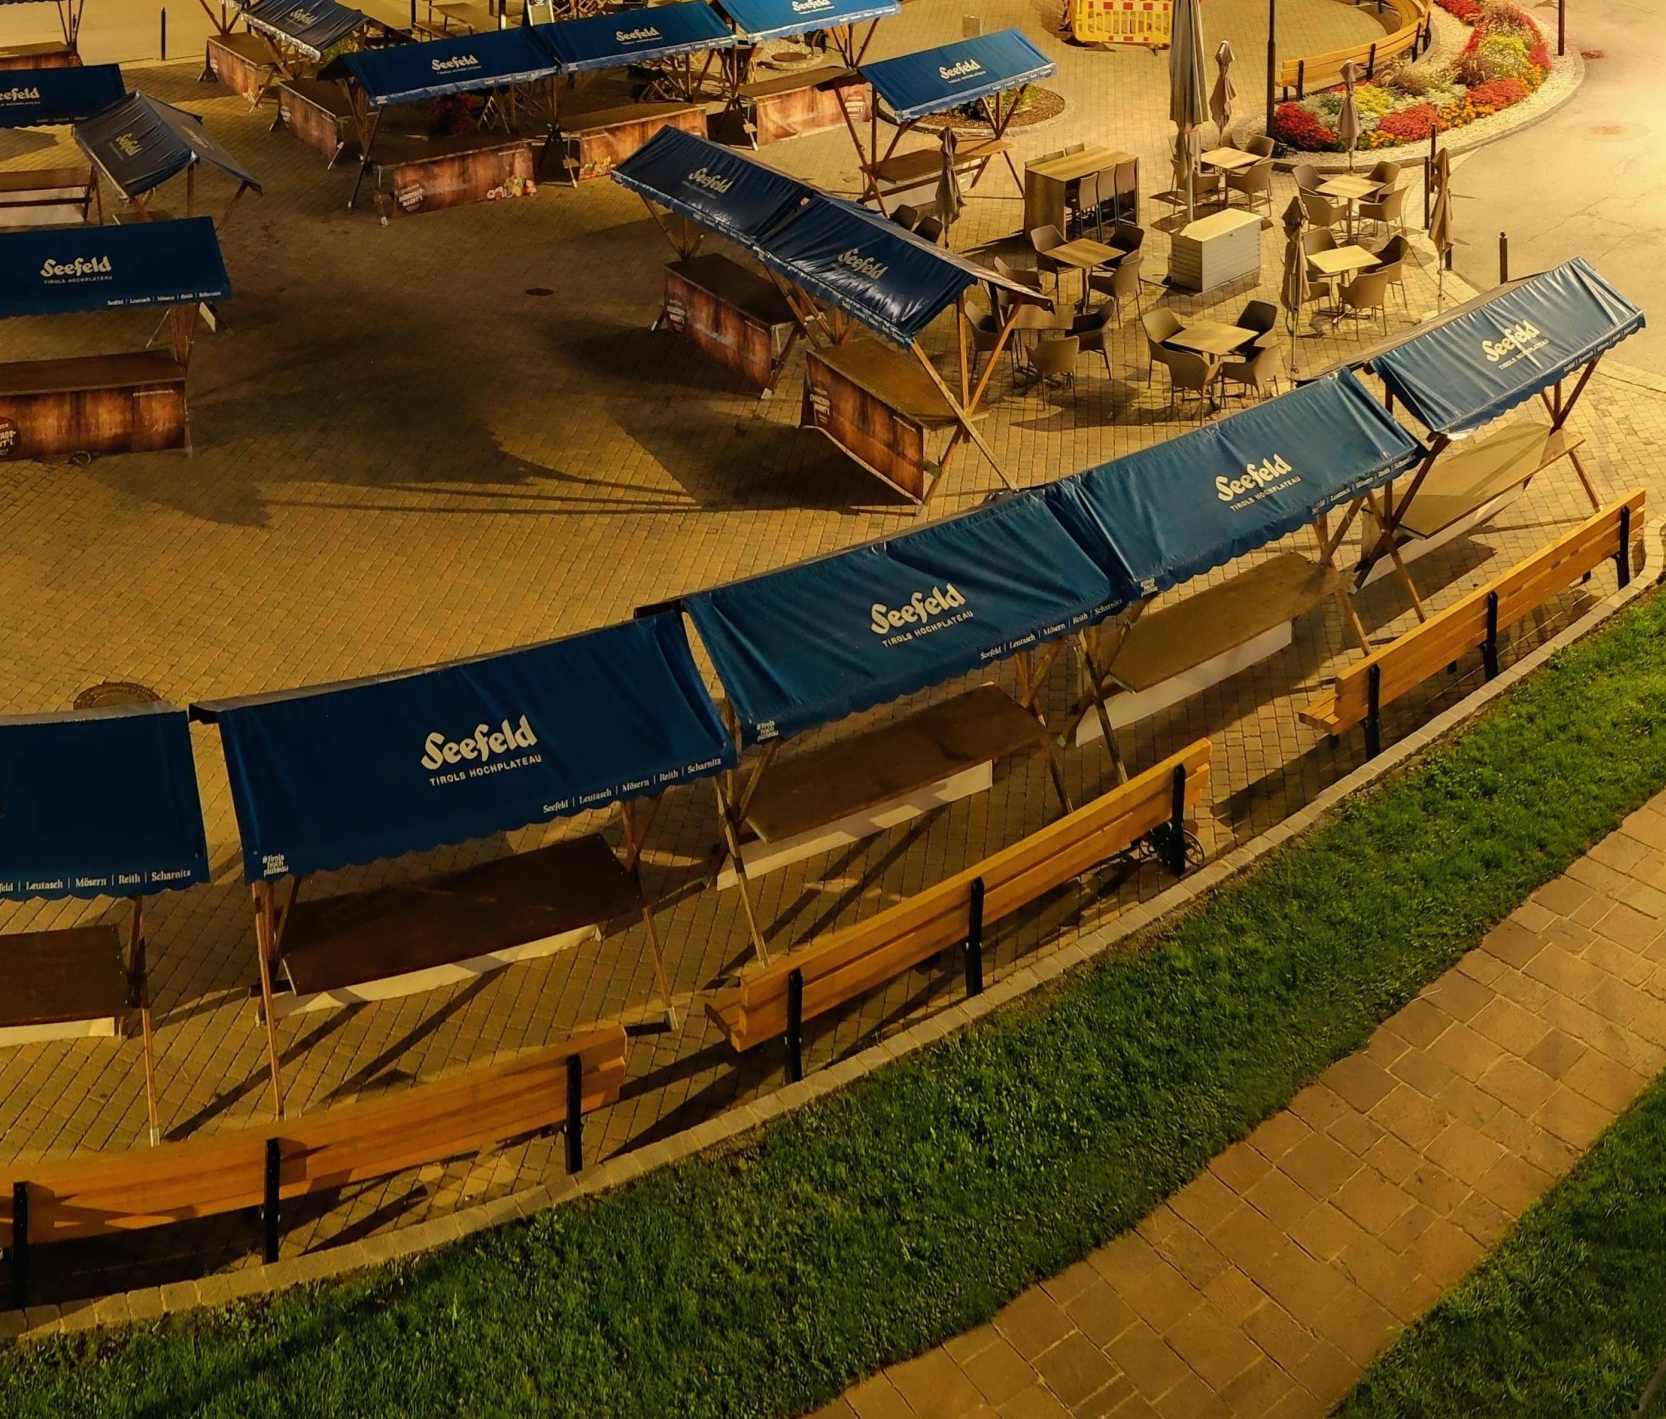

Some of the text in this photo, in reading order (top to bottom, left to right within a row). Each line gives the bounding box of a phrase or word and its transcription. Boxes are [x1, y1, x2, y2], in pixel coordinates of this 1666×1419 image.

[616, 26, 660, 42] Seefeld
[431, 54, 479, 71] Seefeld
[939, 58, 982, 80] Seefeld
[40, 255, 112, 277] Seefeld
[1482, 319, 1540, 362] Seefeld
[1215, 453, 1293, 502] Seefeld
[871, 582, 966, 635] Seefeld
[882, 609, 974, 648] TIROLS HOCHPLATEAU
[421, 714, 538, 770] Seefeld
[429, 753, 542, 787] TIROLS HOCHPLATEAU
[543, 757, 722, 813] Seefeld Leutasch Mösern Reith Scharnitz
[26, 879, 63, 891] Leutasch
[75, 876, 108, 888] Mösern
[118, 873, 141, 885] Reith
[151, 868, 191, 882] Scharnitz
